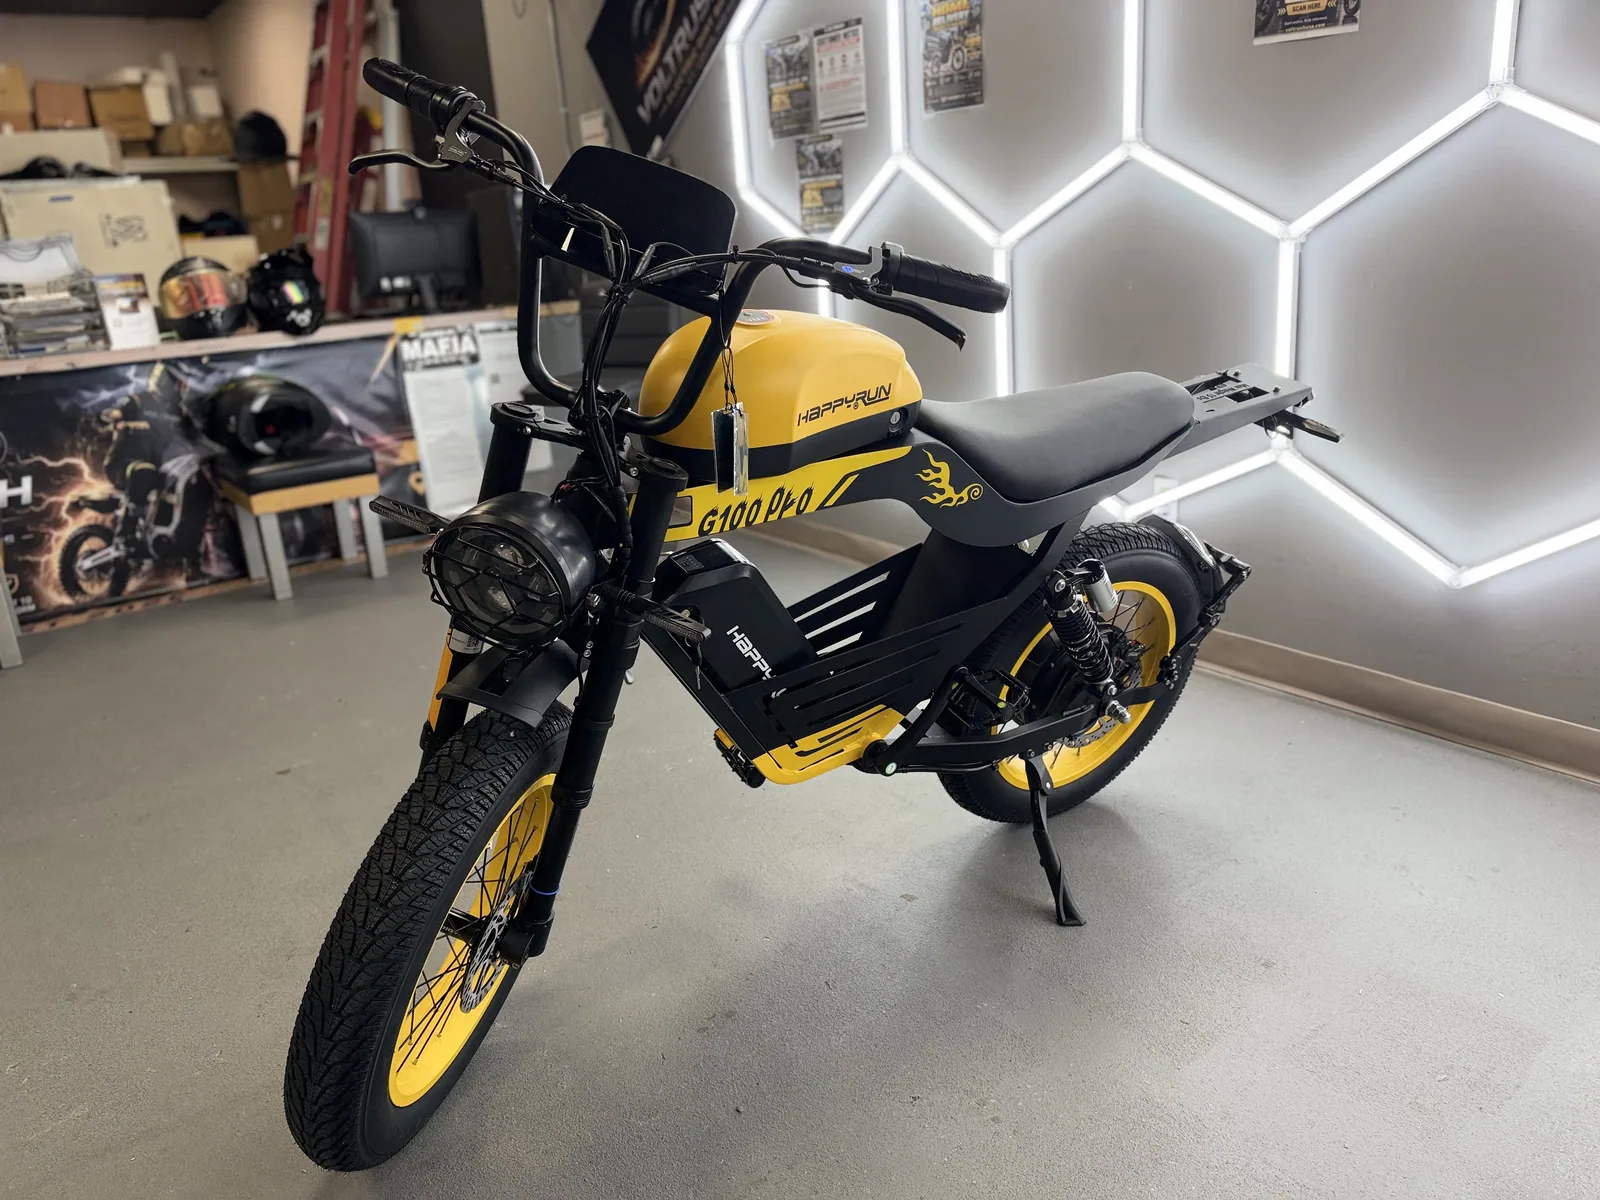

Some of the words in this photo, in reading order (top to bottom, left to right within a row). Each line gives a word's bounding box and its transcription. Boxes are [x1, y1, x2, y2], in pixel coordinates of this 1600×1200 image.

[1292, 4, 1307, 12] SCAN
[401, 332, 477, 361] MAFIA
[698, 494, 763, 537] G100
